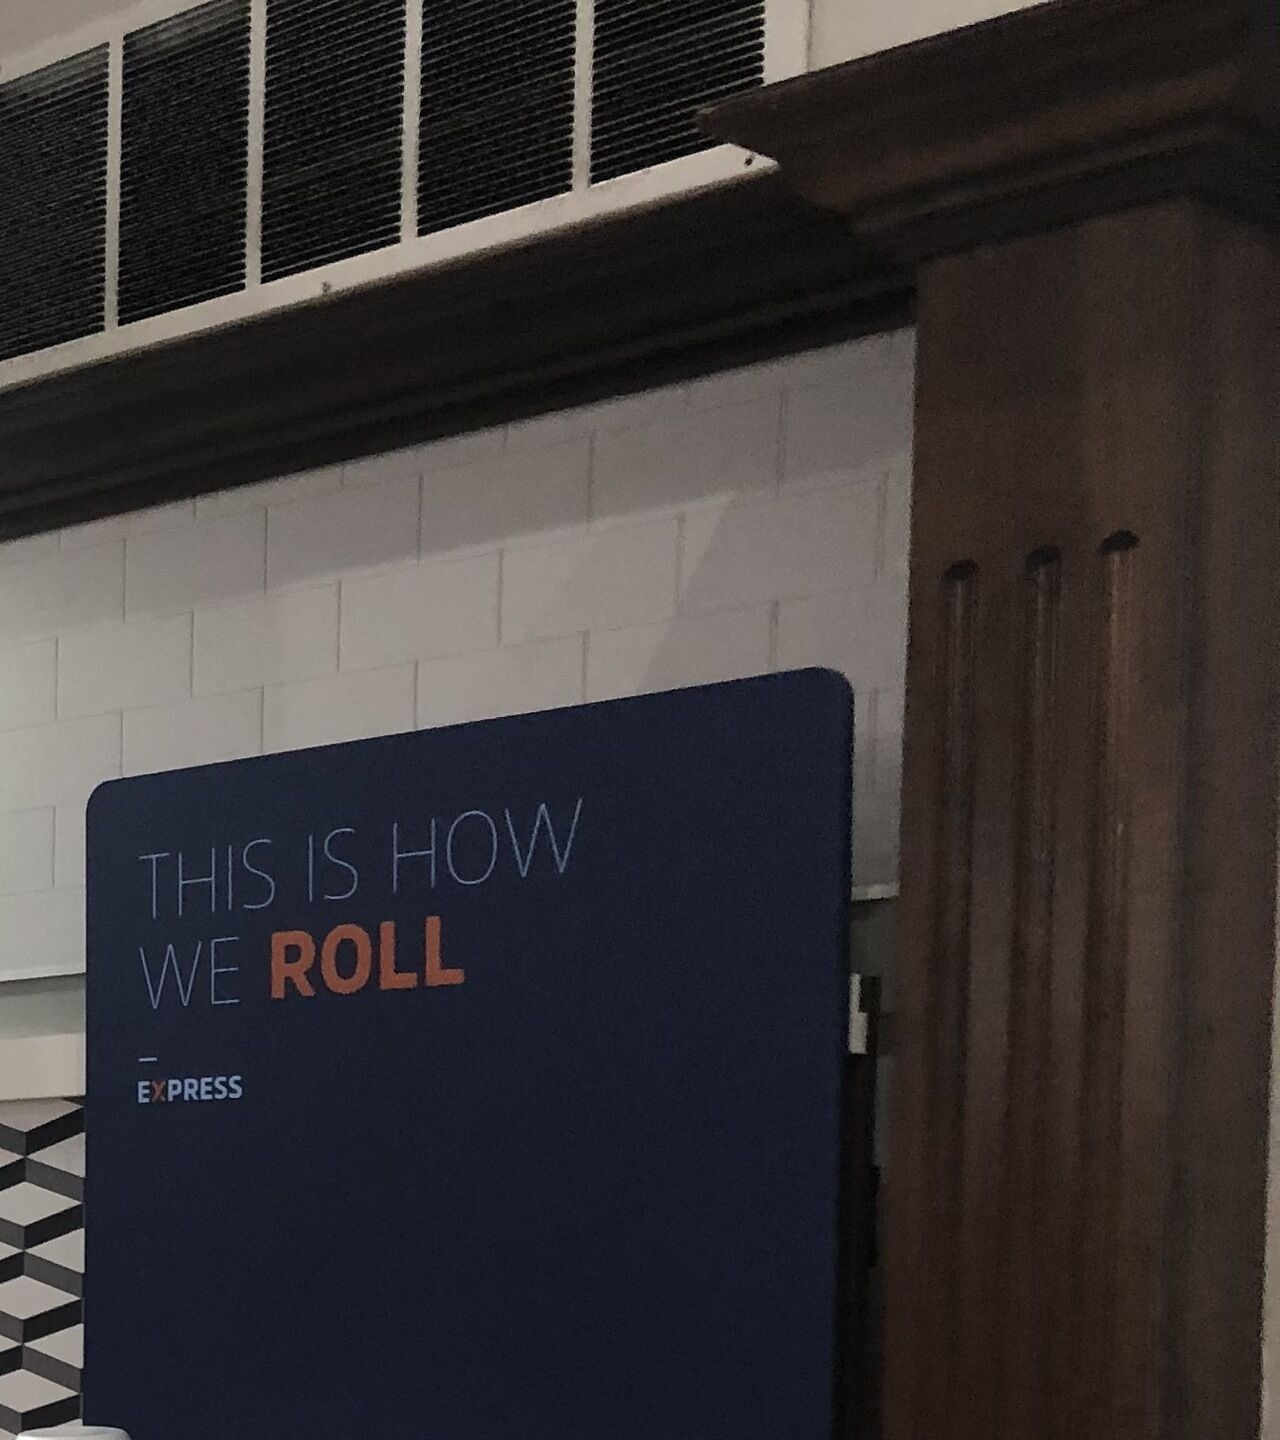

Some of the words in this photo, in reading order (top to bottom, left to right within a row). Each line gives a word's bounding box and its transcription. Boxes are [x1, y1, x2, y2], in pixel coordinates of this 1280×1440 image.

[139, 838, 277, 919] THIS
[308, 827, 360, 902] IS
[392, 798, 583, 893] HOW
[139, 936, 241, 1009] WE
[270, 915, 466, 999] ROLL
[137, 1075, 243, 1103] EXPRESS
